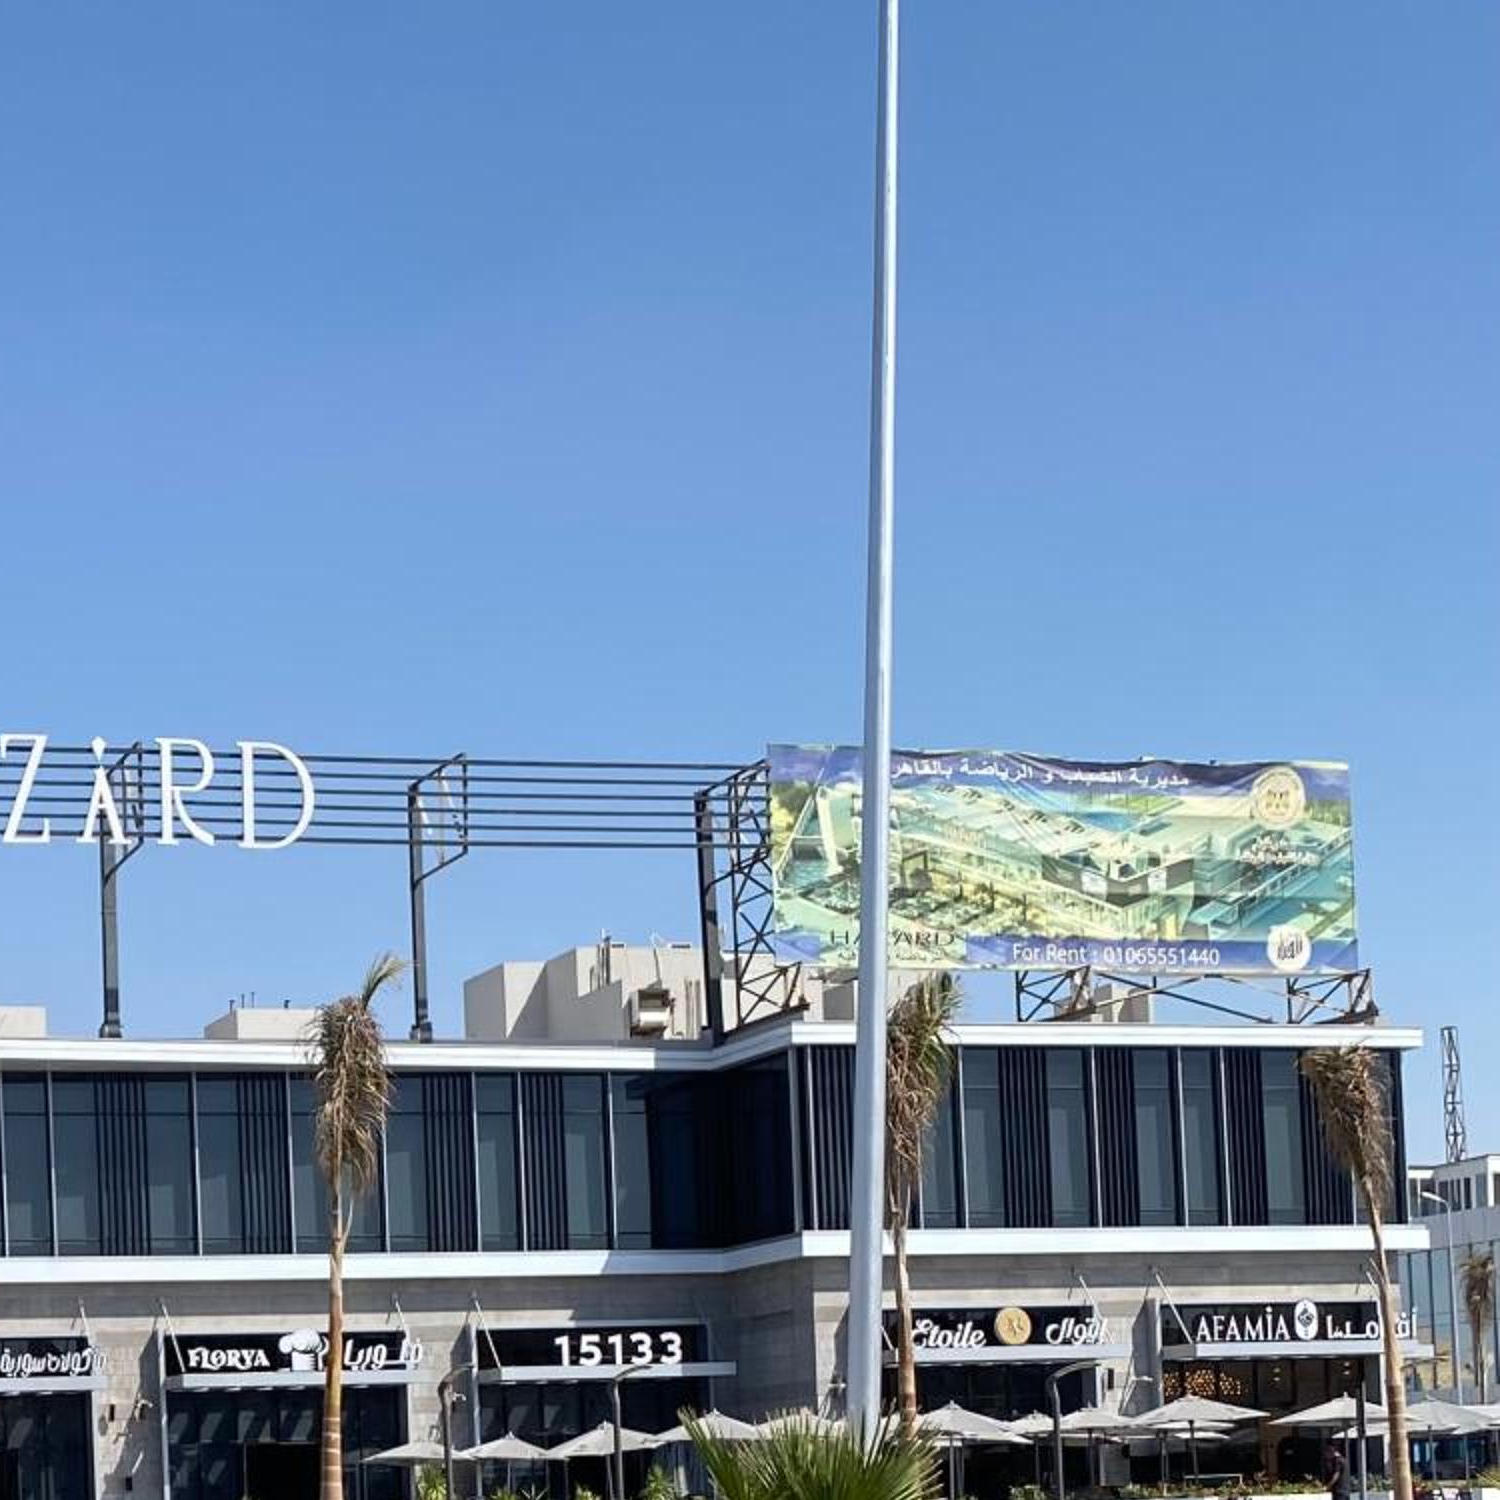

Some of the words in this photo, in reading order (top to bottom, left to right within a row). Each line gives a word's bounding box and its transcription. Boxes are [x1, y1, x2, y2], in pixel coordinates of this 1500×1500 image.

[890, 757, 953, 780] بالقاهر
[959, 757, 1033, 783] الرياضة
[1129, 767, 1189, 788] مديرية
[830, 929, 957, 945] HARD
[1012, 942, 1041, 962] For
[1047, 944, 1086, 963] Rent
[1104, 946, 1220, 966] 01065551440
[1325, 1306, 1419, 1340] أفميا
[187, 1347, 271, 1371] FLORYA
[554, 1331, 683, 1366] 15133
